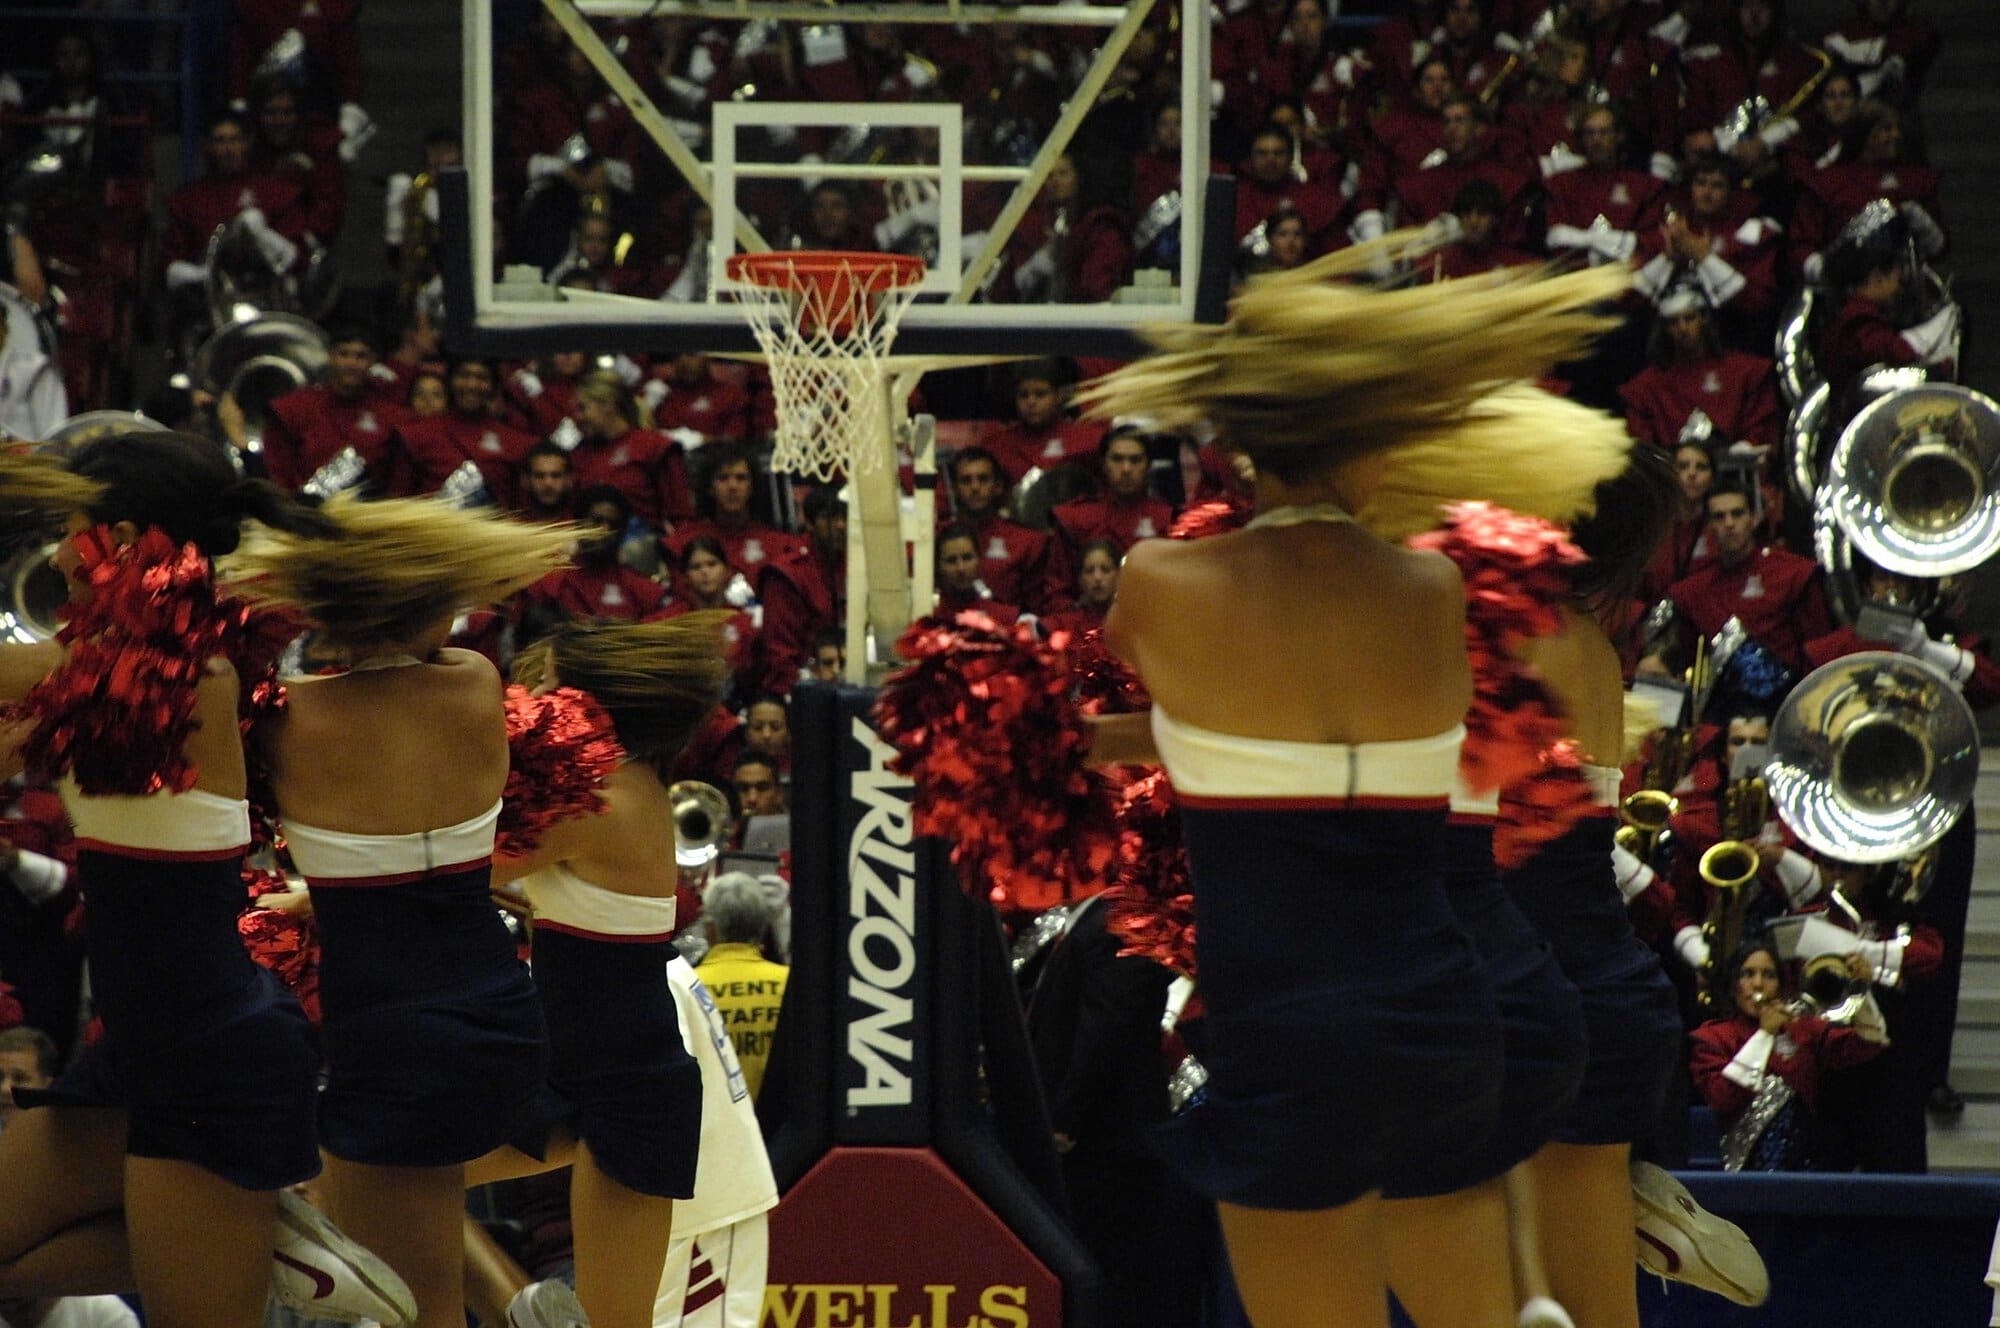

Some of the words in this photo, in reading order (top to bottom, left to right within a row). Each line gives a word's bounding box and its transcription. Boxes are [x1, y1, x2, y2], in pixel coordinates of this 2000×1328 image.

[848, 715, 916, 1107] ARIZONA
[719, 1006, 781, 1024] TAFF
[758, 1284, 1030, 1328] WELLS
